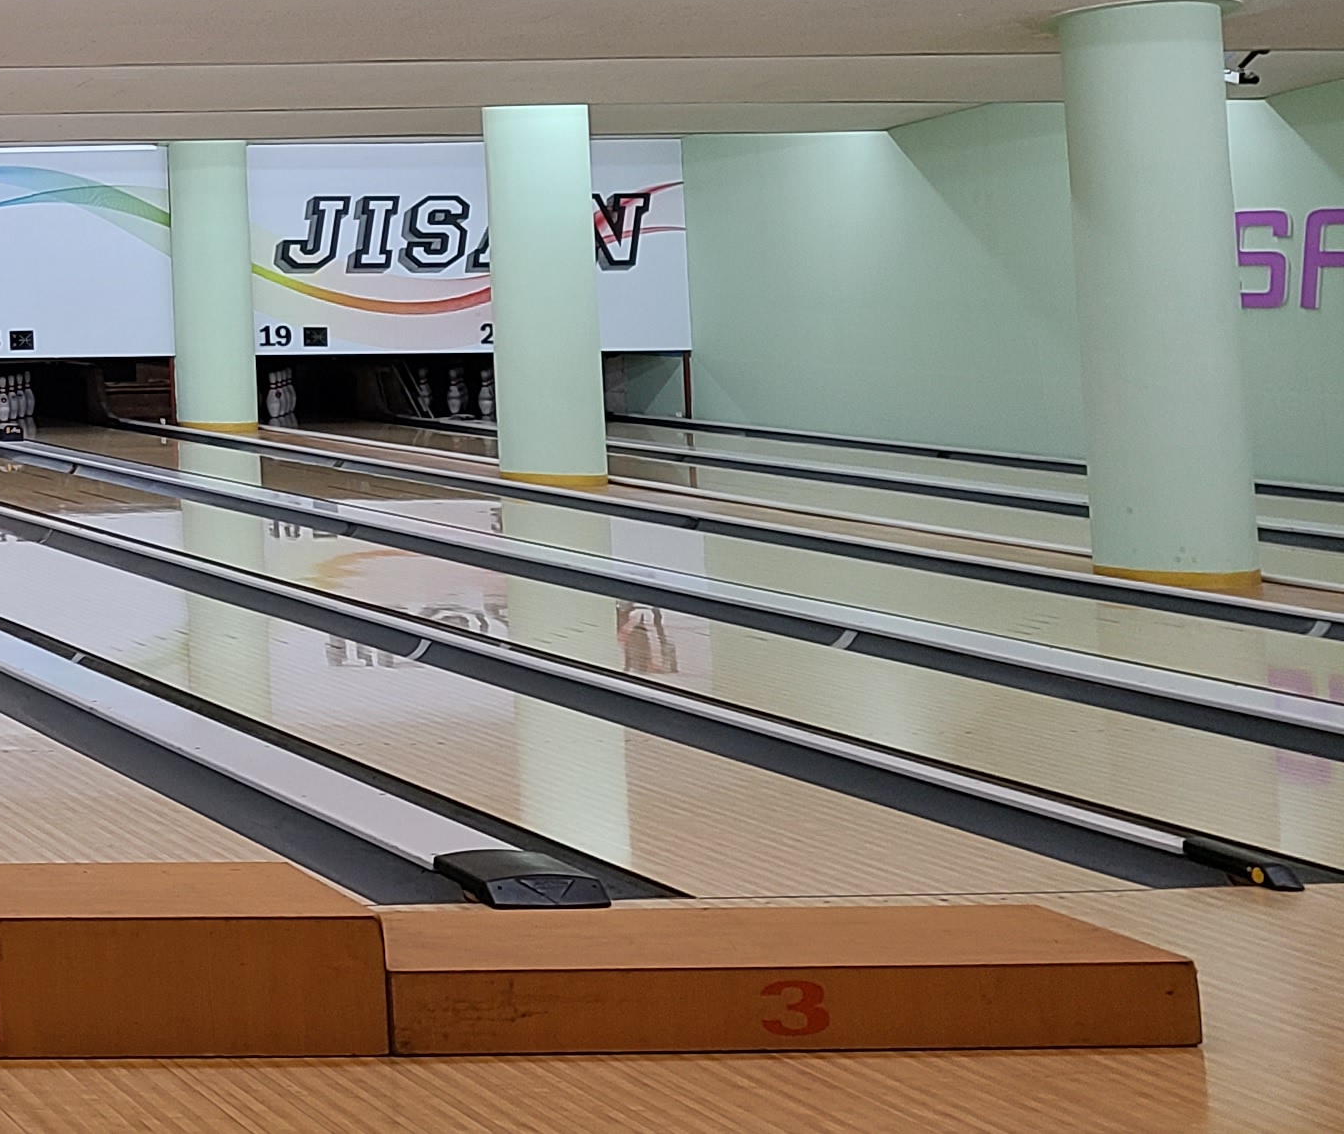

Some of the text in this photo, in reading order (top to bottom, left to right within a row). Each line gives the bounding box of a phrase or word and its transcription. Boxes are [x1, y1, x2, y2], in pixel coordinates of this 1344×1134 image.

[274, 194, 651, 274] JISN
[259, 326, 292, 347] 19
[479, 323, 494, 345] 2
[760, 980, 831, 1036] 3
